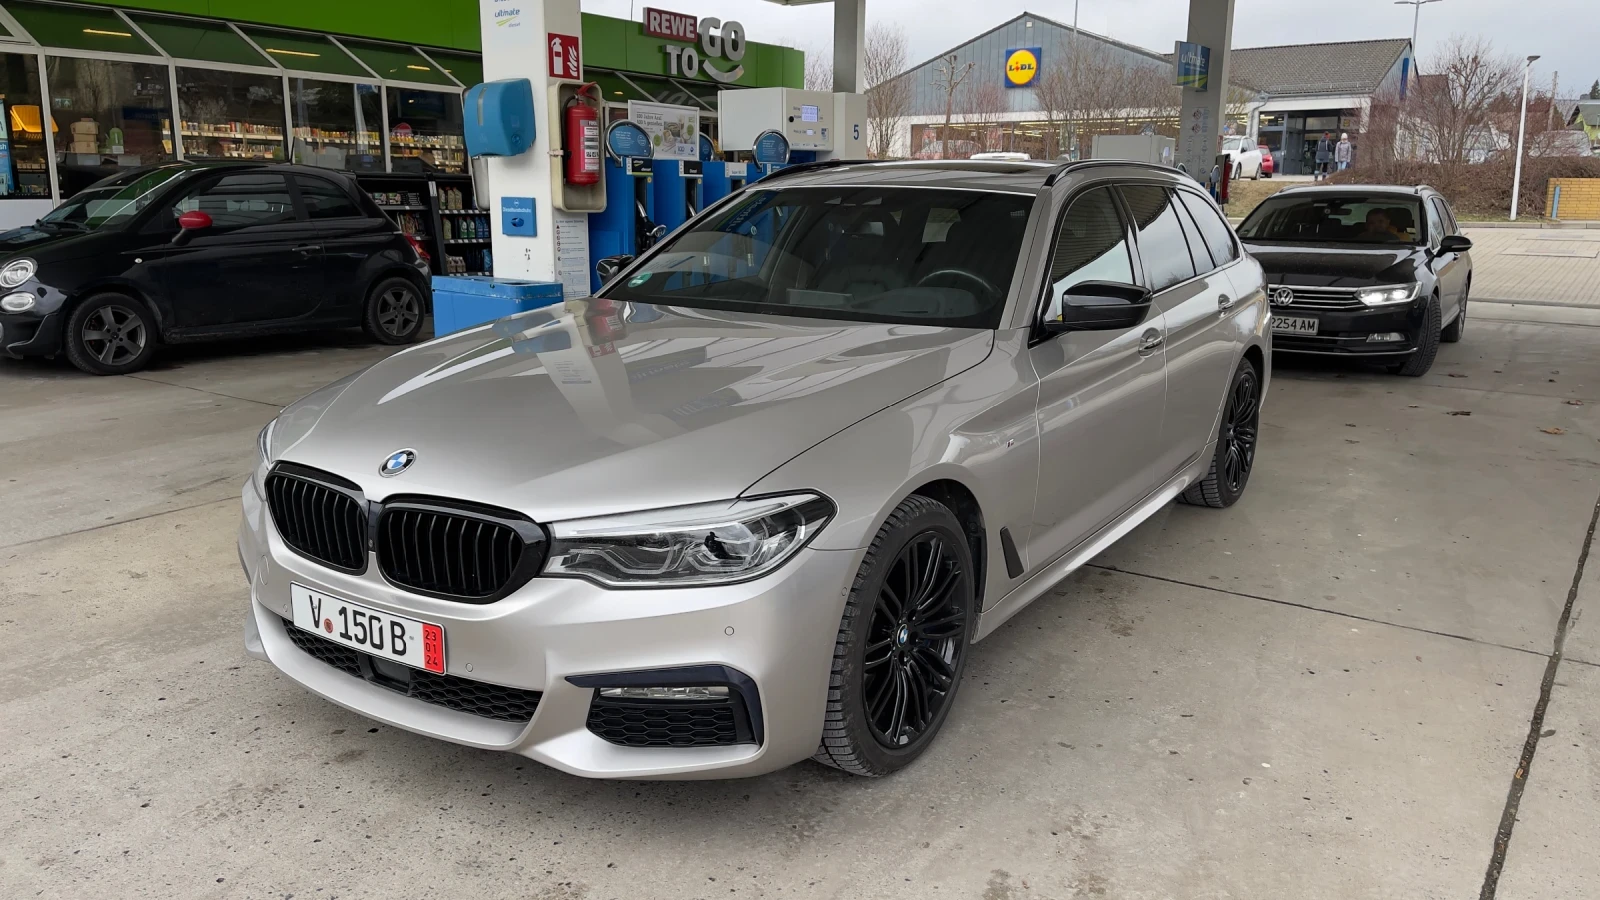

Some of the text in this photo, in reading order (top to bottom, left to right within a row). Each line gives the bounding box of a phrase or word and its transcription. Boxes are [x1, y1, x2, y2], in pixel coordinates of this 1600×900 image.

[650, 11, 695, 38] REWE
[699, 17, 745, 61] GO
[665, 44, 699, 78] TO
[853, 124, 859, 140] 5
[1300, 319, 1316, 331] AM
[309, 595, 407, 656] V 150 B
[425, 629, 437, 642] 23
[426, 654, 438, 667] 24
